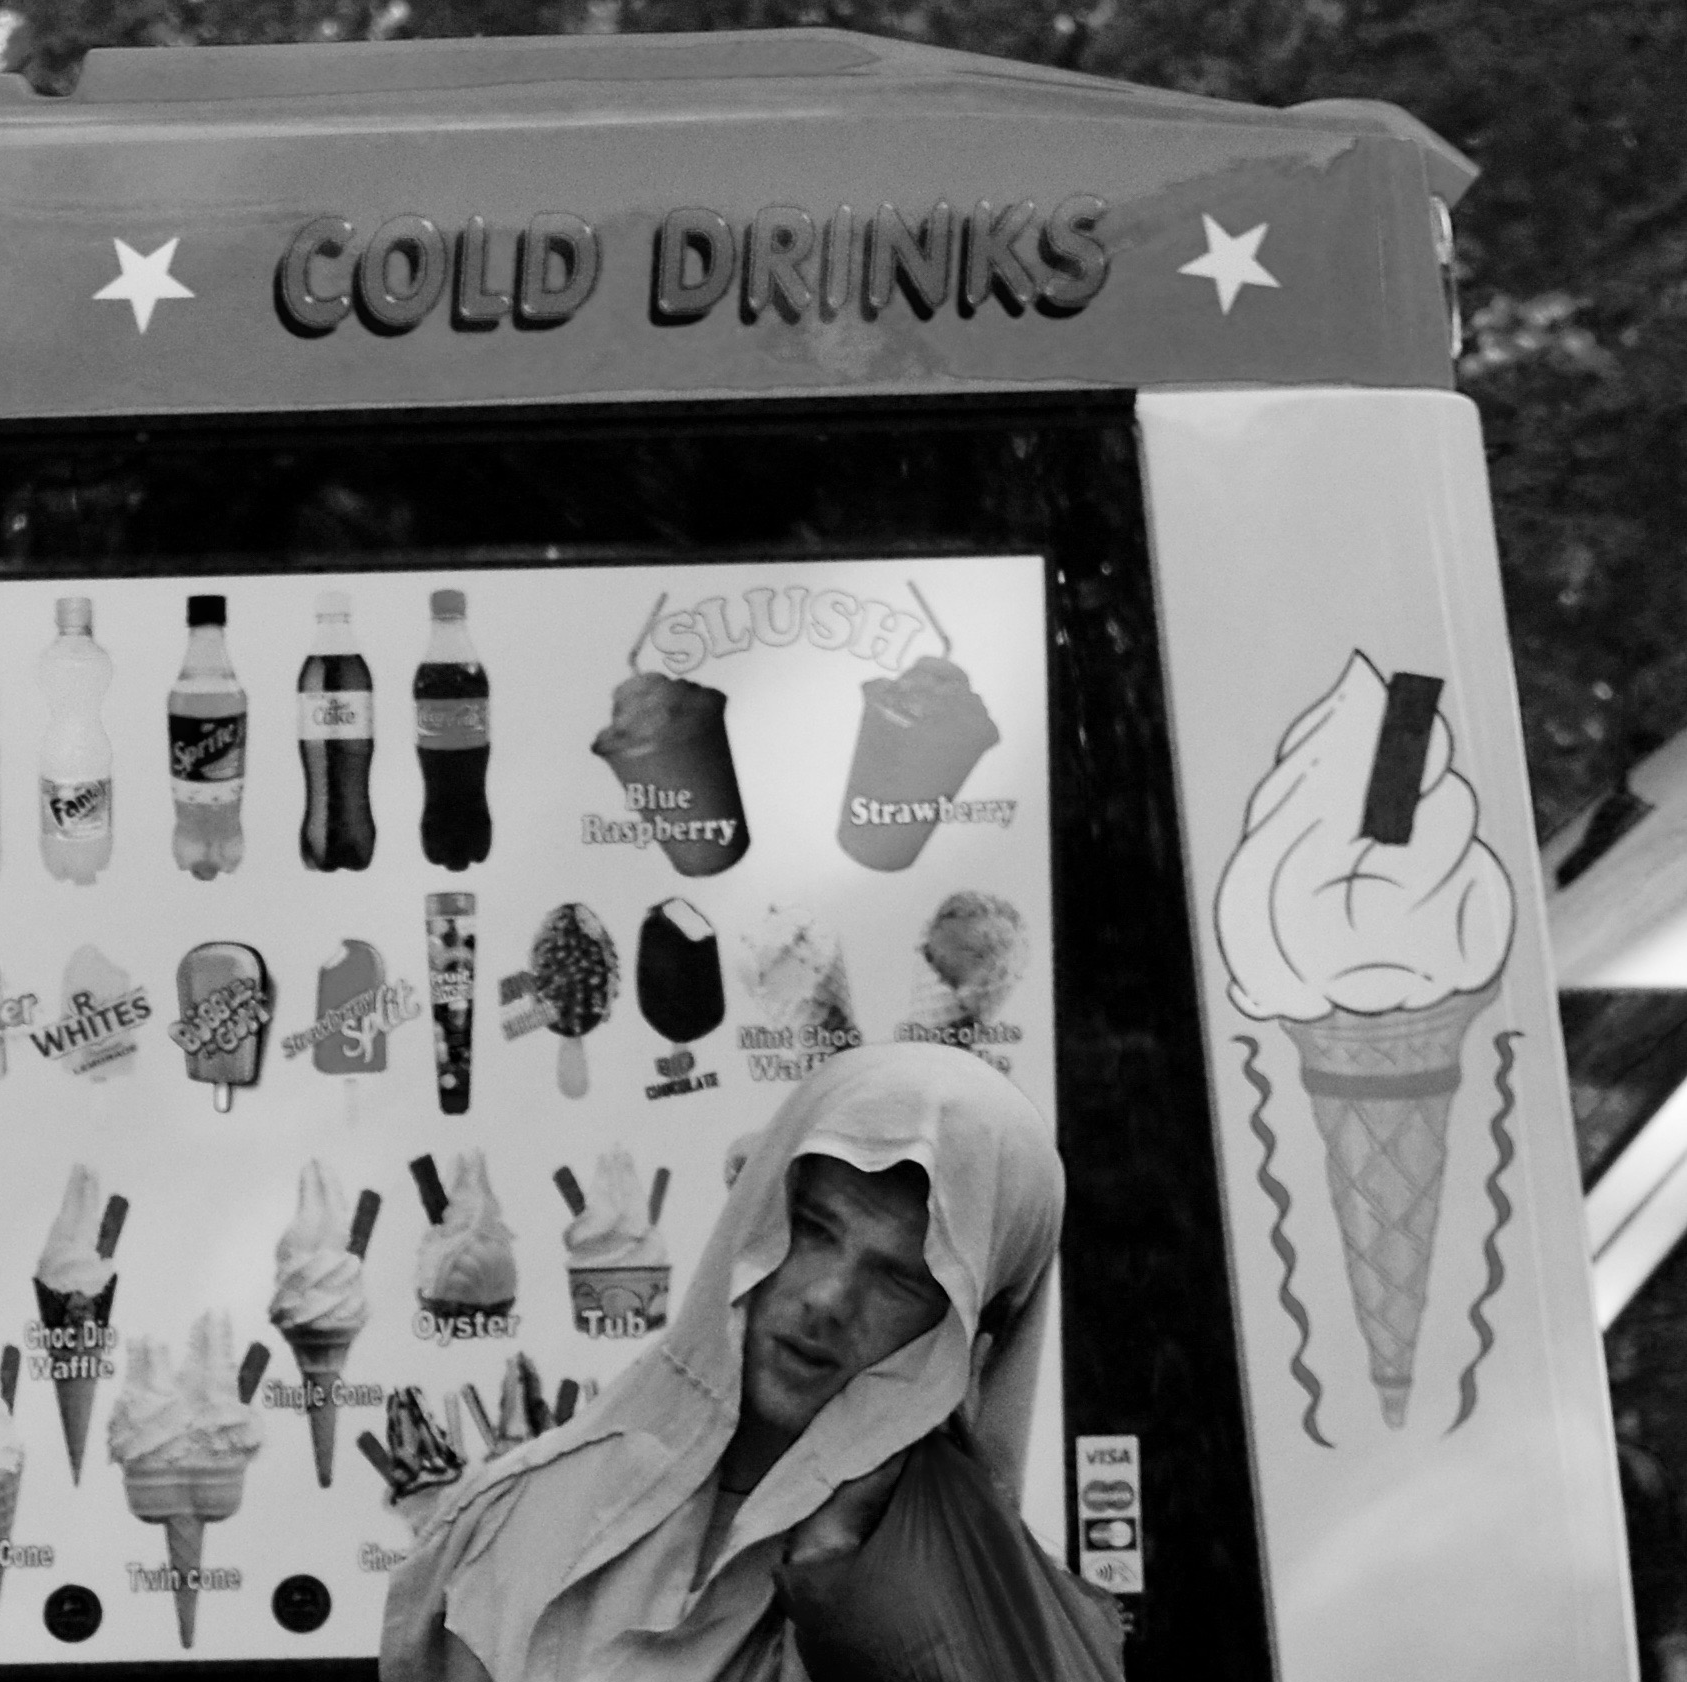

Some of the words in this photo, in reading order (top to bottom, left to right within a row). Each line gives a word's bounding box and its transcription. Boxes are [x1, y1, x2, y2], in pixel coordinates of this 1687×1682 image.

[275, 209, 601, 338] COLD
[649, 195, 1110, 325] DRINKS
[650, 586, 924, 676] SLUSH
[625, 783, 692, 811] Blue
[849, 795, 1018, 828] Strawberry
[581, 814, 737, 849] Raspberry
[29, 995, 152, 1058] WHITES
[340, 977, 422, 1064] Split
[737, 1024, 794, 1049] Mint
[799, 1023, 861, 1047] Choc
[893, 1021, 1023, 1045] Chocolate
[25, 1320, 79, 1350] Choc
[82, 1319, 119, 1354] Dip
[412, 1311, 520, 1347] Oyster
[580, 1308, 648, 1340] Tub
[26, 1353, 116, 1381] Waffle
[263, 1378, 326, 1414] Single
[330, 1379, 384, 1406] Cone
[1086, 1448, 1132, 1465] VISA
[125, 1561, 181, 1592] Twin
[186, 1566, 243, 1591] cone
